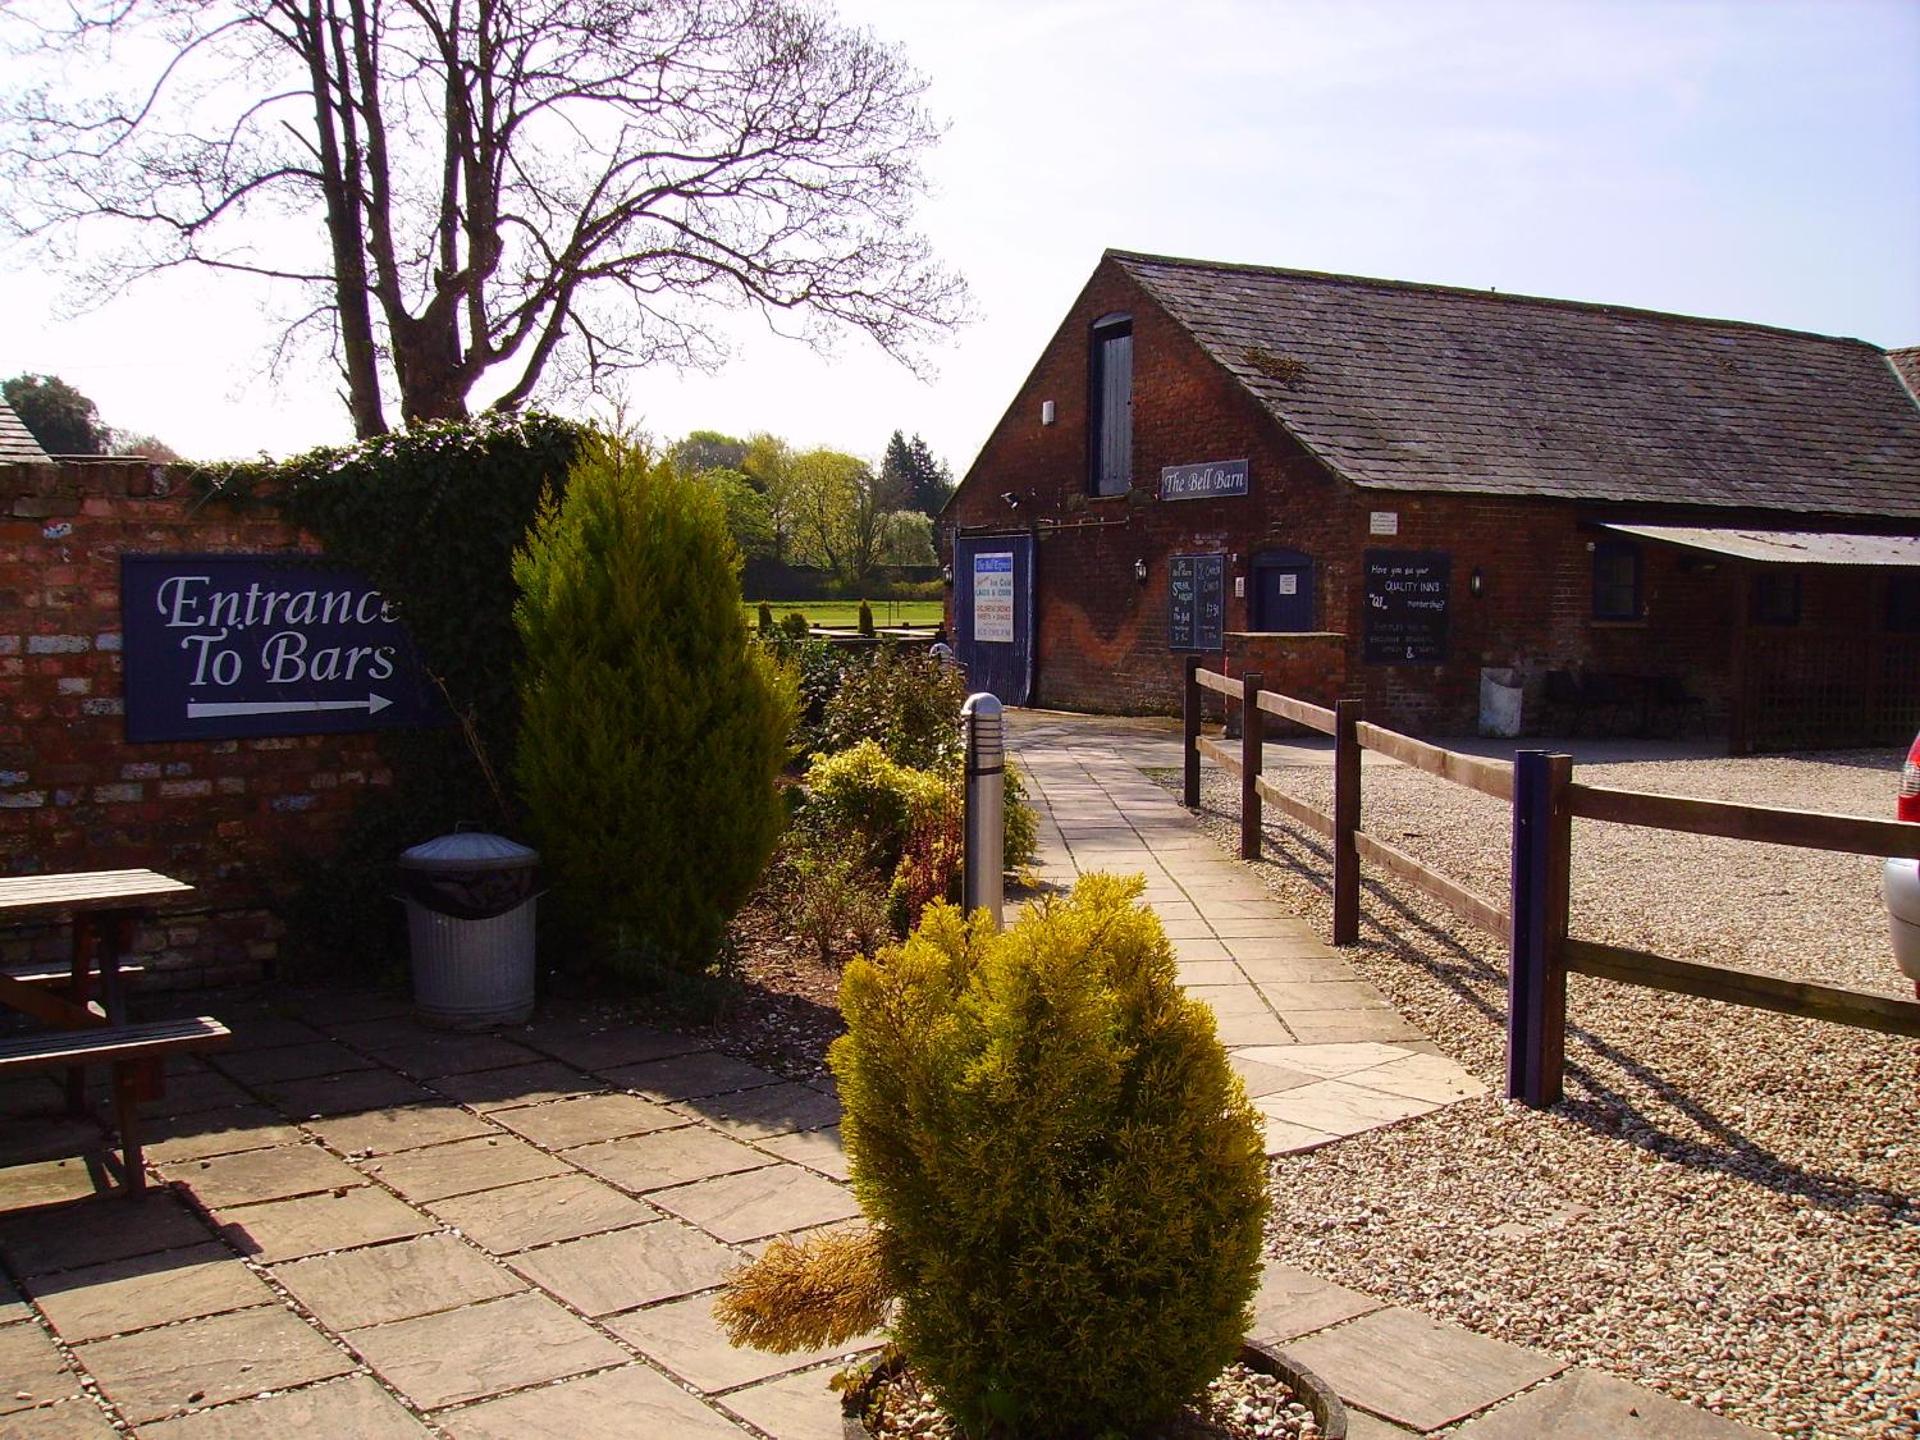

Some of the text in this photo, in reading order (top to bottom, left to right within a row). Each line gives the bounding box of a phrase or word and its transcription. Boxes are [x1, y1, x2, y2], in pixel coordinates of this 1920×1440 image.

[1165, 468, 1243, 493] The Bell Barn
[1371, 565, 1387, 574] Have
[1391, 568, 1402, 577] you
[1384, 581, 1418, 593] QUALITY
[157, 576, 401, 628] Entrance
[181, 627, 396, 686] To Bars
